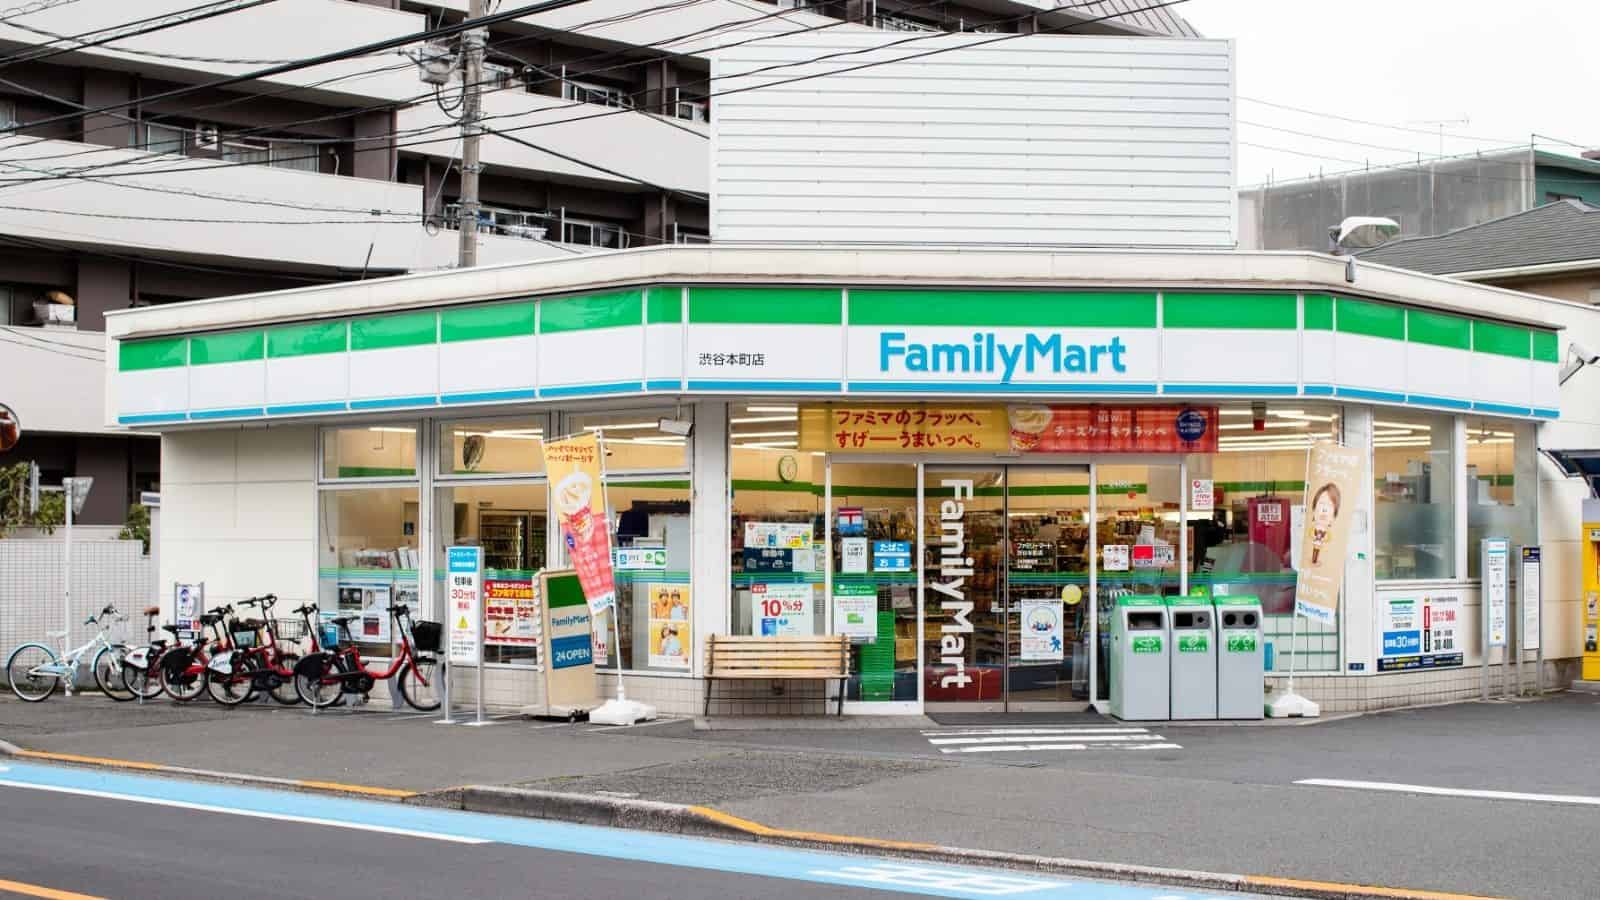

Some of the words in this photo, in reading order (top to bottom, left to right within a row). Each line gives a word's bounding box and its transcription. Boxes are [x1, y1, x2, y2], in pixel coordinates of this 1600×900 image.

[698, 352, 765, 367] 渋谷本町店
[879, 331, 1127, 386] FamilyMart
[836, 408, 983, 426] ファミマのフラッペ、
[879, 543, 905, 552] たばこ
[929, 479, 975, 689] FamilyMart
[551, 614, 590, 628] FamilyMart
